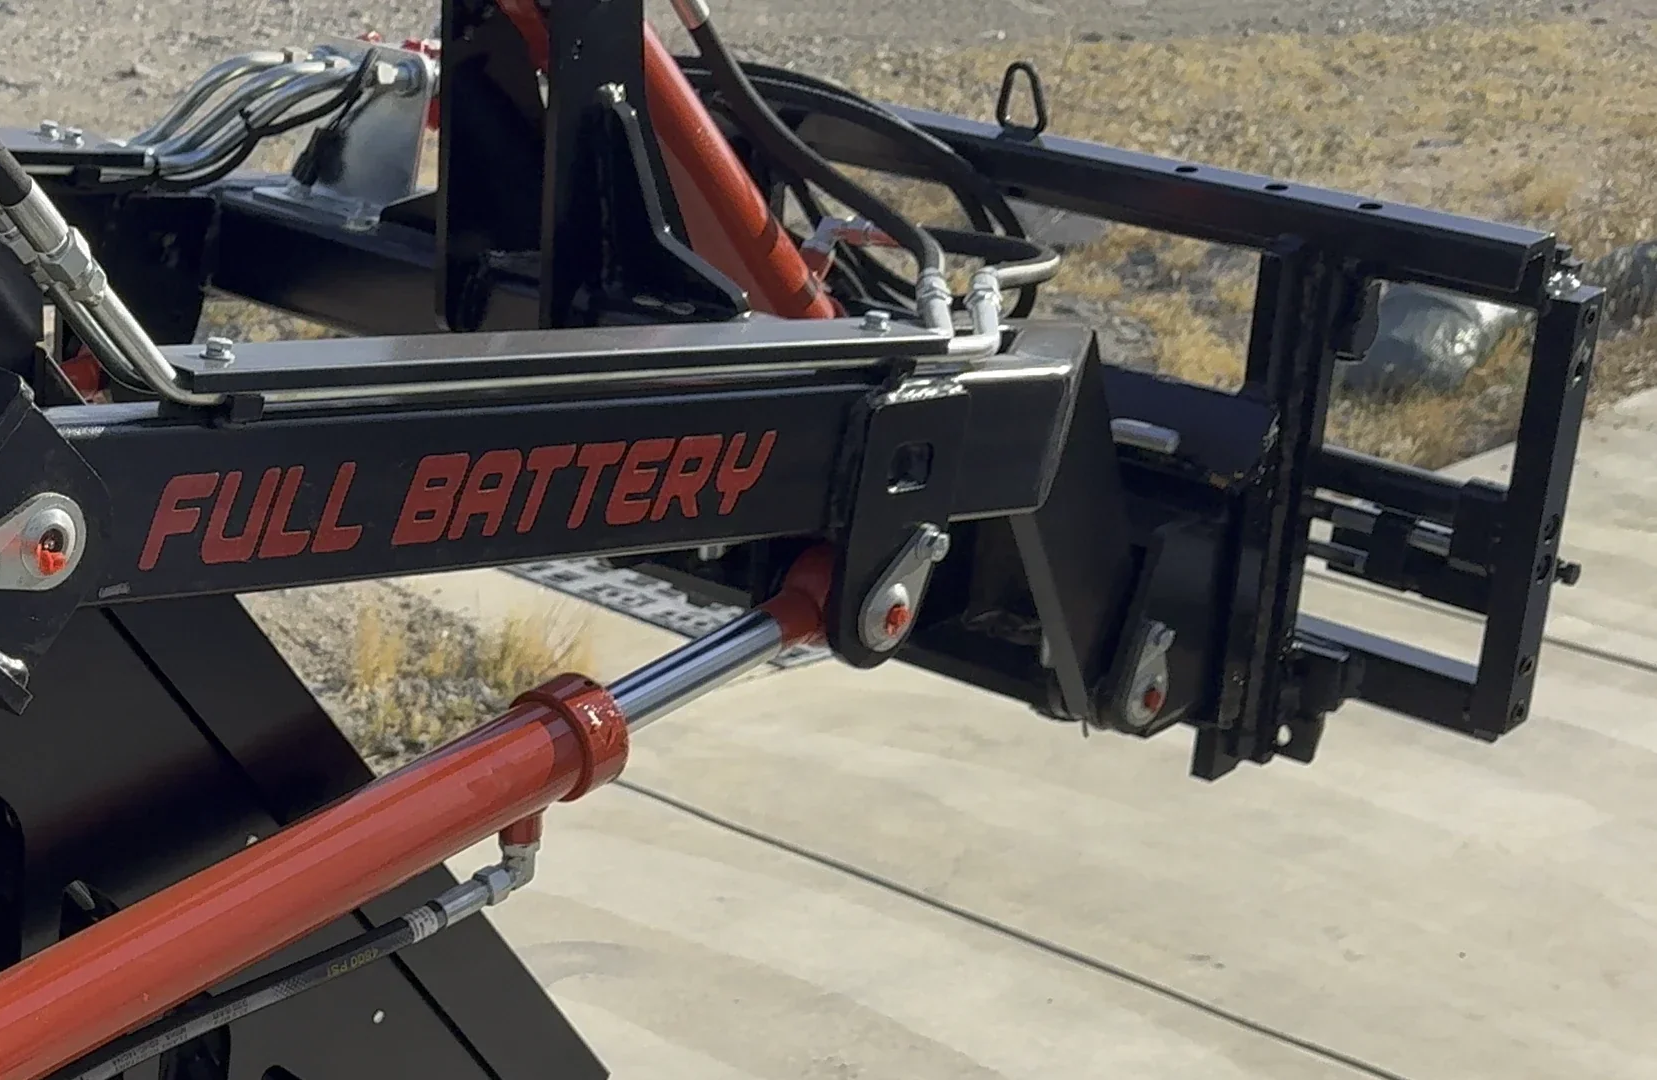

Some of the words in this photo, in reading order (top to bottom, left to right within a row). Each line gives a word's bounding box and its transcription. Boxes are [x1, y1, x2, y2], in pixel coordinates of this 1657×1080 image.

[138, 461, 363, 571] FULL
[391, 429, 777, 547] BATTERY
[327, 958, 349, 977] PSI
